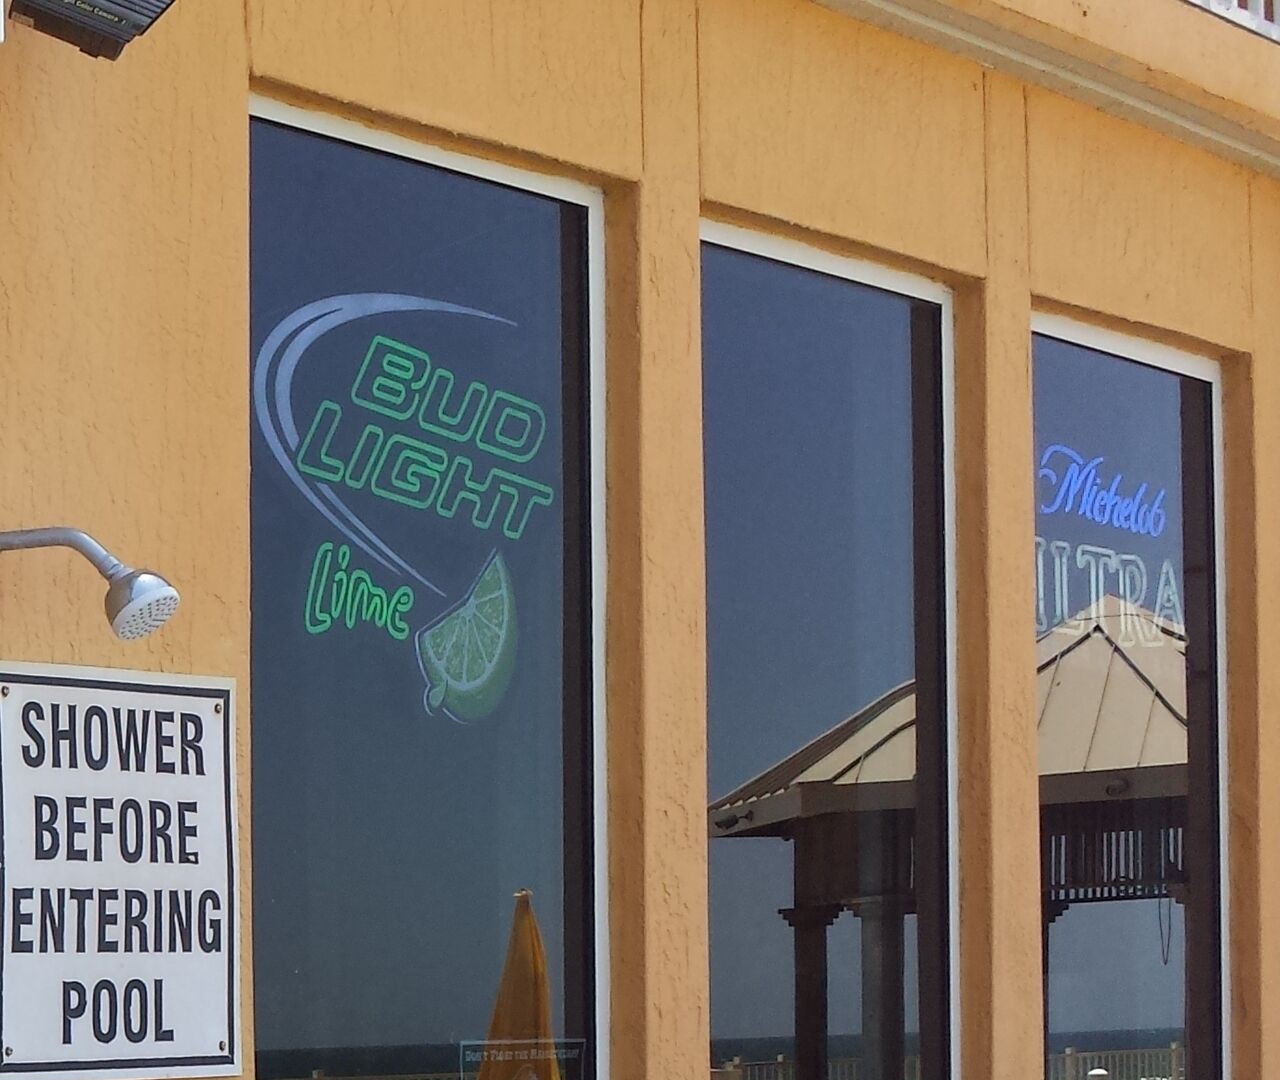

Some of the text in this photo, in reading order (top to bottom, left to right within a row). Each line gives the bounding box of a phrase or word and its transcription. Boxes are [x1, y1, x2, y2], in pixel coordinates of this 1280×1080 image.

[93, 7, 119, 22] Camera
[351, 335, 546, 463] BUD
[297, 400, 554, 540] LIGHT
[305, 541, 415, 640] Lime
[21, 701, 206, 776] SHOWER
[34, 795, 199, 864] BEFORE
[10, 887, 222, 953] ENTERING
[62, 978, 175, 1045] POOL
